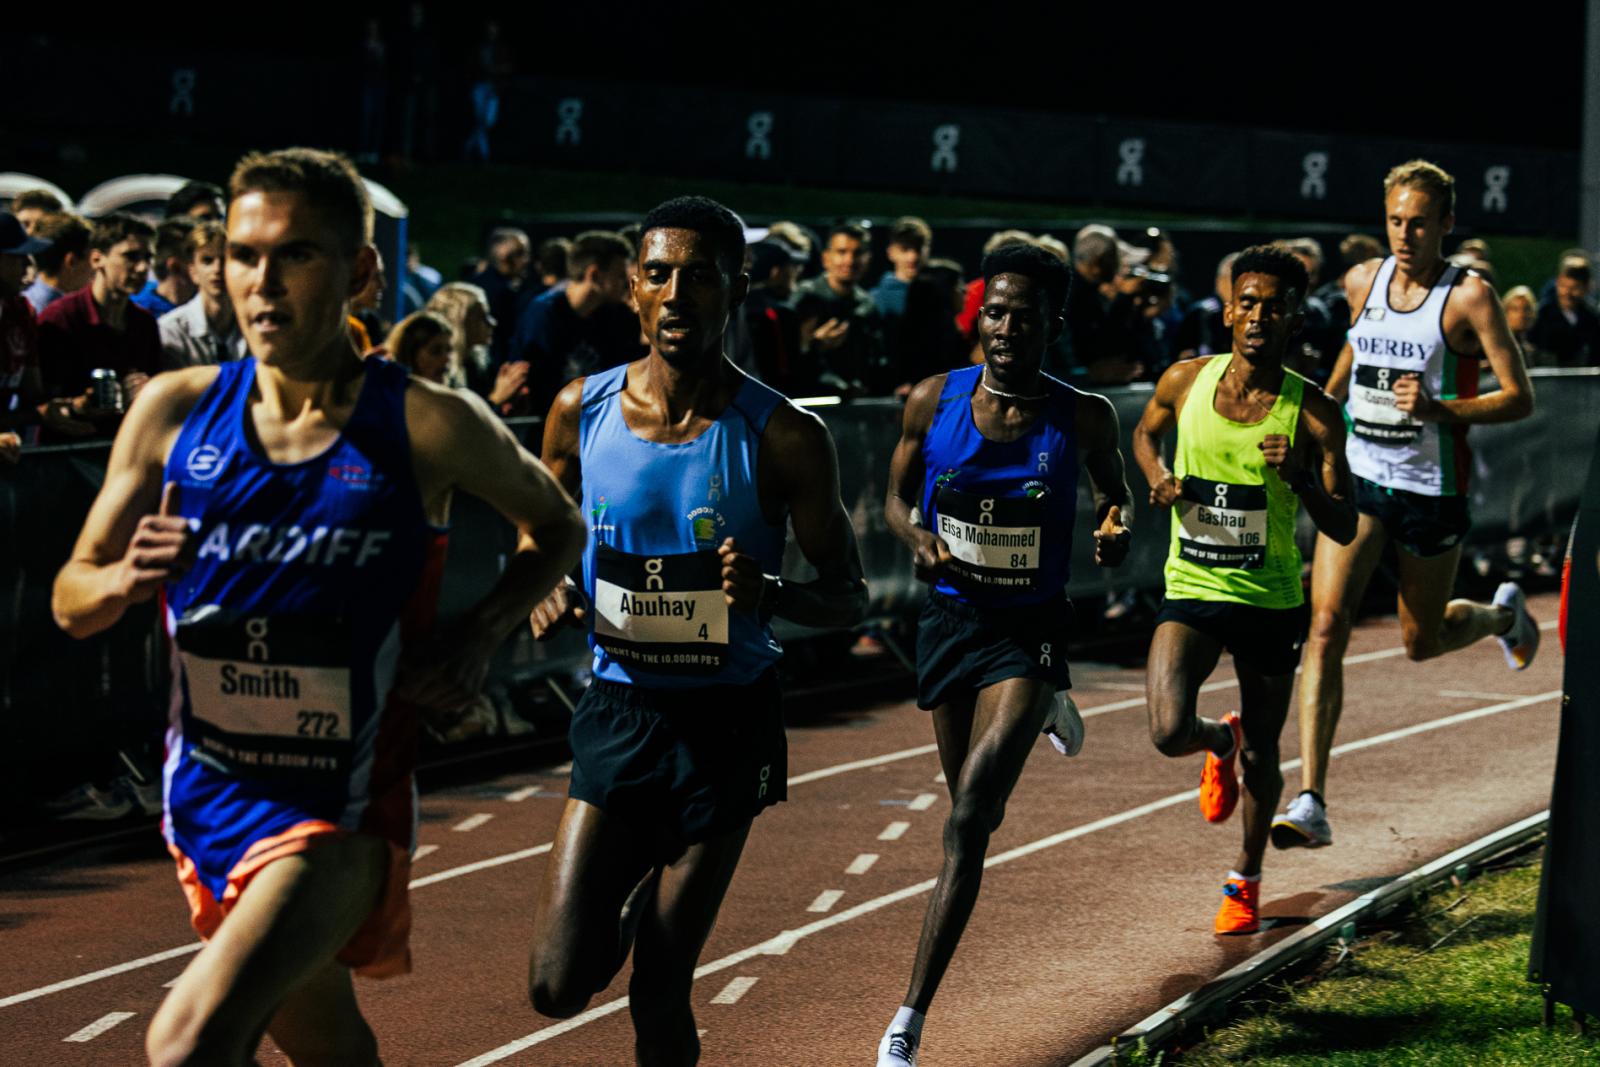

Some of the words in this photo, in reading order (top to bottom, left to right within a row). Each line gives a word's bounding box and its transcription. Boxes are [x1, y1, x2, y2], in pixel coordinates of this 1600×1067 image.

[1356, 336, 1433, 361] DERBY
[1197, 507, 1247, 528] Gashau
[188, 516, 393, 568] ARDIFF
[941, 516, 962, 540] Eisa
[965, 525, 1036, 548] Mohammed
[1238, 532, 1261, 545] 106
[1010, 554, 1028, 569] 84
[620, 593, 696, 621] Abuhay
[697, 624, 709, 640] 4
[641, 653, 659, 664] THE
[219, 664, 300, 699] Smith
[297, 711, 340, 737] 272
